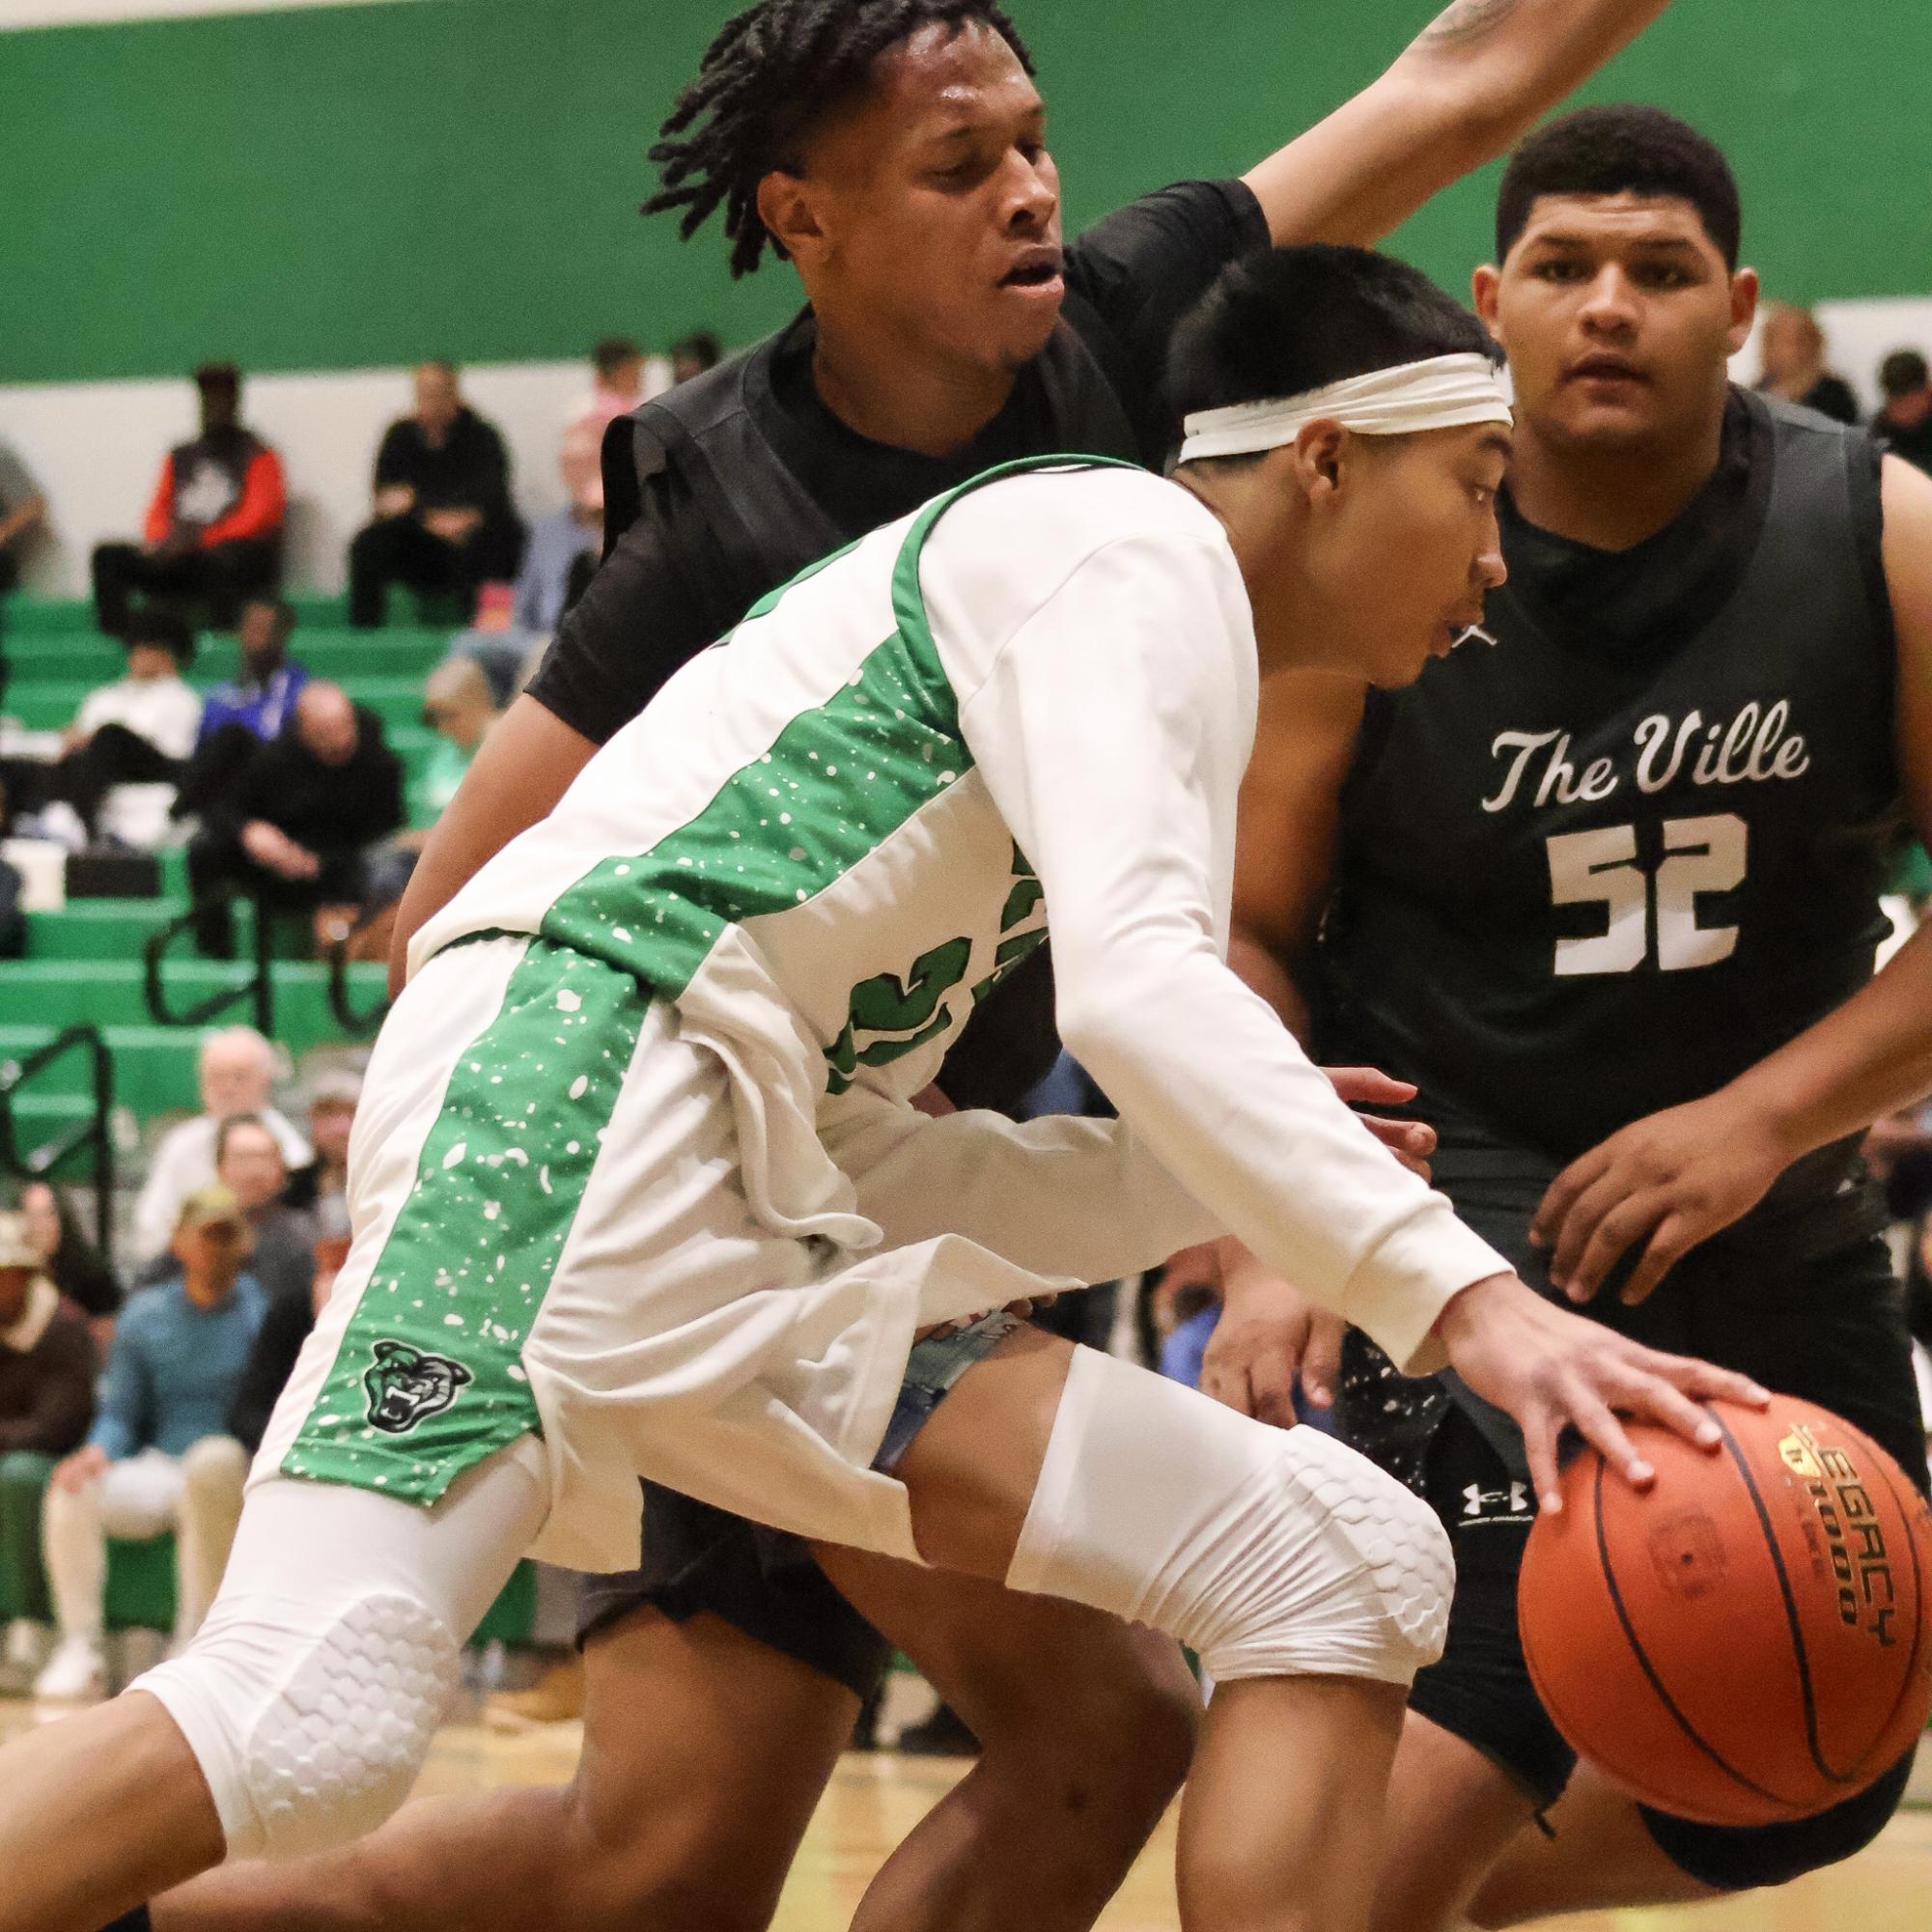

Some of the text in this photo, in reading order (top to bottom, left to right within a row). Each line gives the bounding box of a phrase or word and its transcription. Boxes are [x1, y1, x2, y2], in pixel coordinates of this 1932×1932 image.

[1482, 699, 1810, 813] The Ville
[1546, 813, 1749, 975] 52
[1808, 1483, 1858, 1625] 1000
